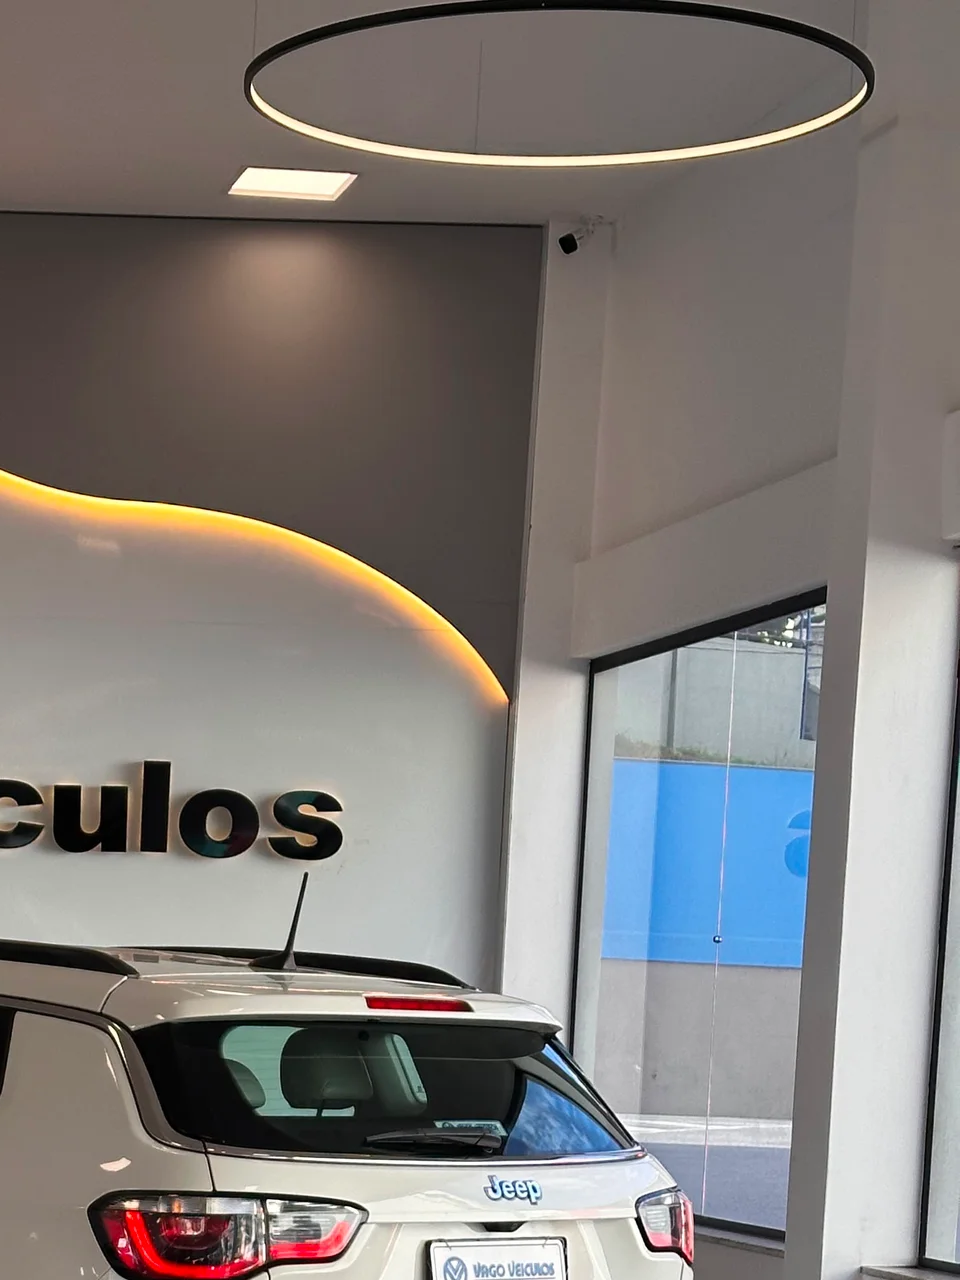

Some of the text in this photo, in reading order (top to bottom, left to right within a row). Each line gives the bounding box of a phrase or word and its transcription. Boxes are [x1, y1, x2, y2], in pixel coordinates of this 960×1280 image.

[483, 1174, 543, 1206] Jeep
[472, 1260, 556, 1278] VAGO VEICULOS
